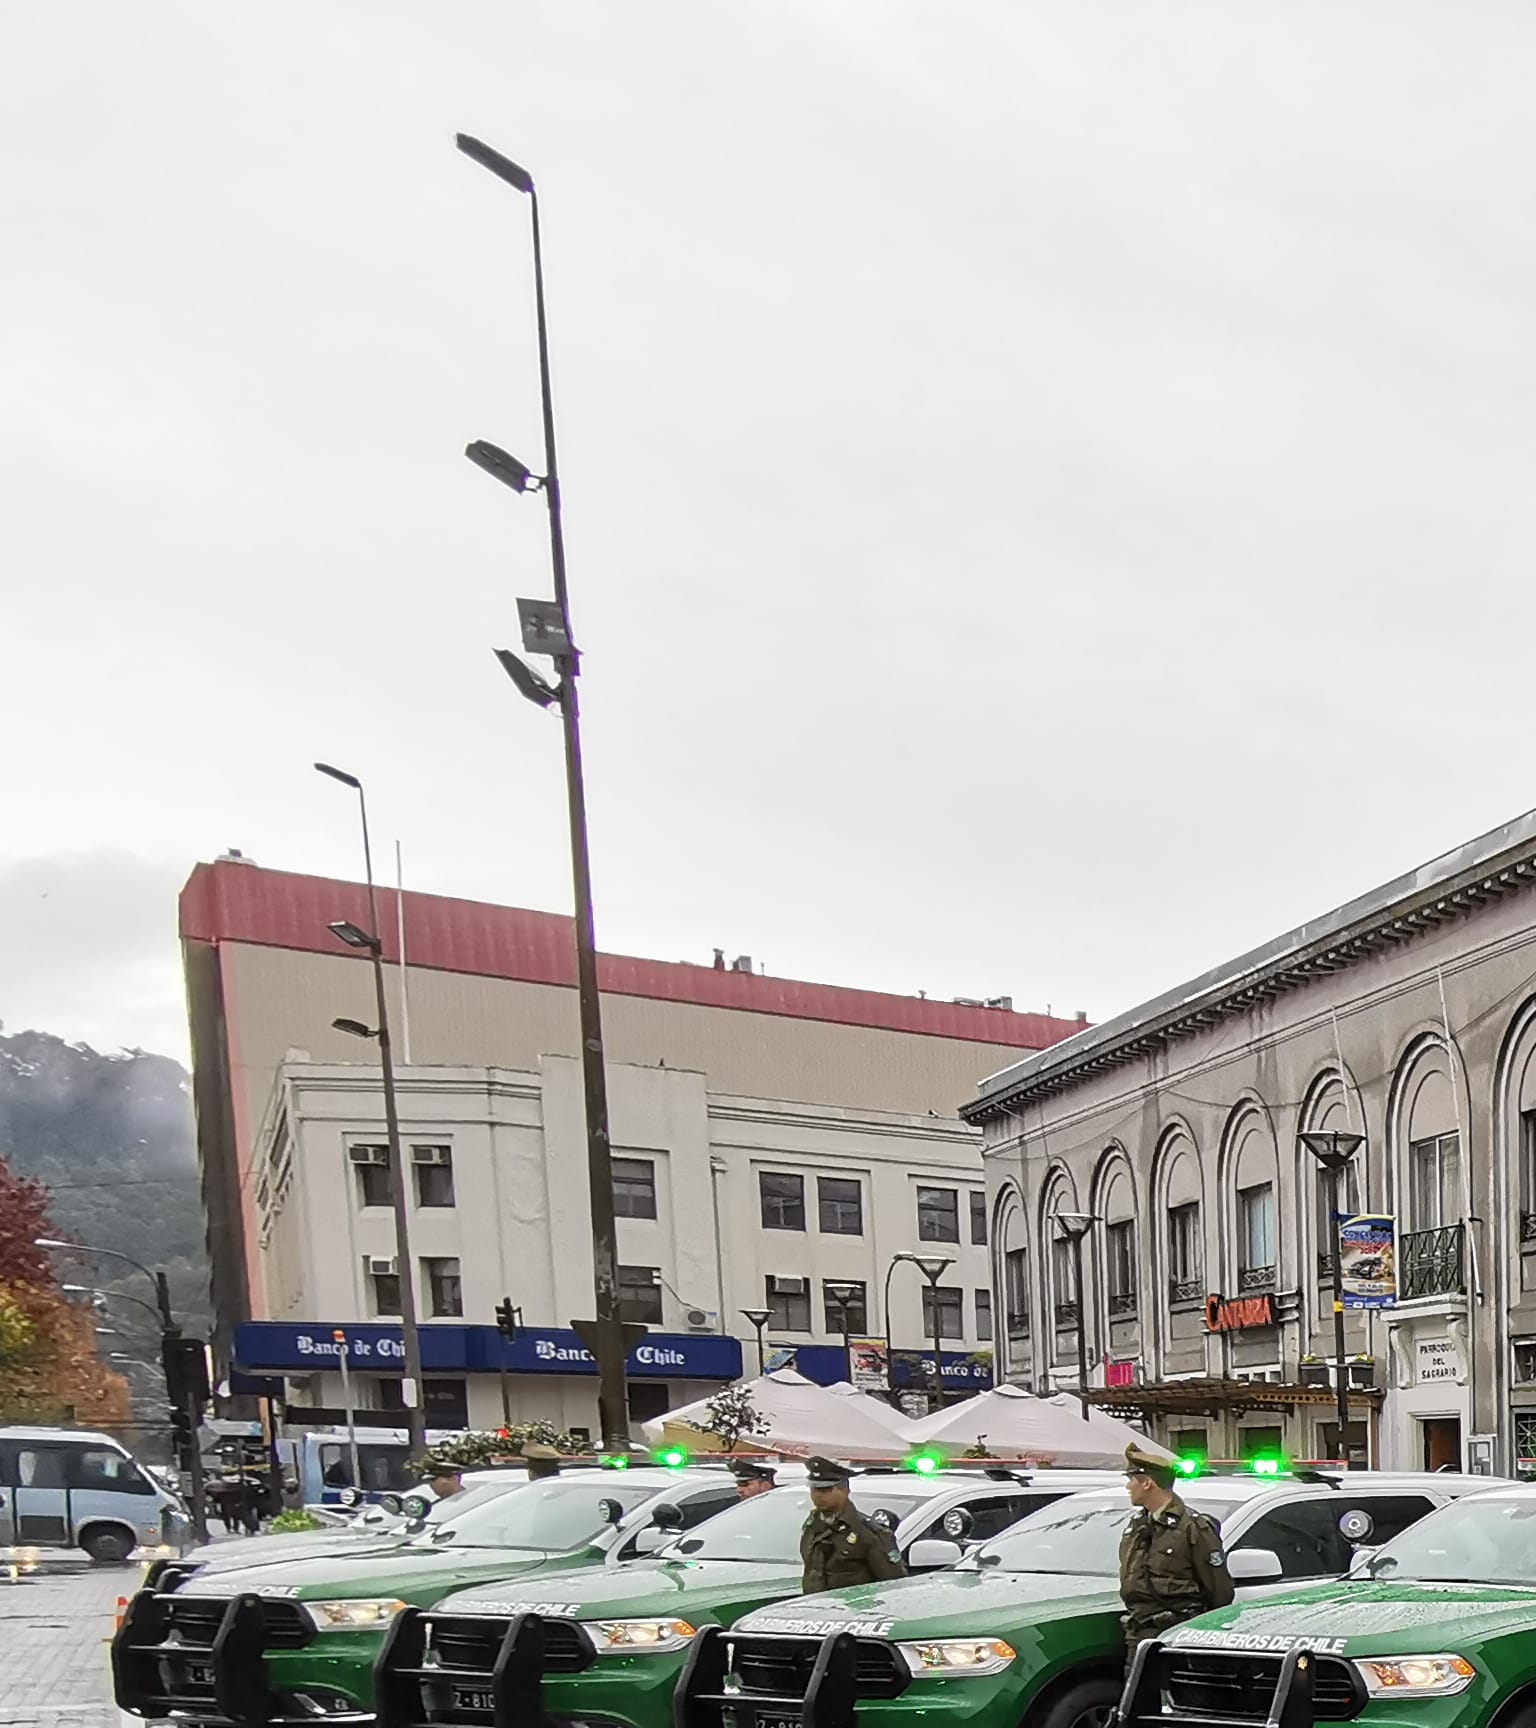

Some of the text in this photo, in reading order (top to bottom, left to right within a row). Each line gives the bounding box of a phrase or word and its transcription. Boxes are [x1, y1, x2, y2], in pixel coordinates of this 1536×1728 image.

[297, 1335, 405, 1357] Banco de Chi
[535, 1340, 686, 1366] Banc Chile
[534, 1604, 581, 1617] CHILE
[842, 1622, 894, 1636] CHILE
[1175, 1630, 1348, 1654] CARABINEROS DE CHILE
[472, 1693, 496, 1708] 810
